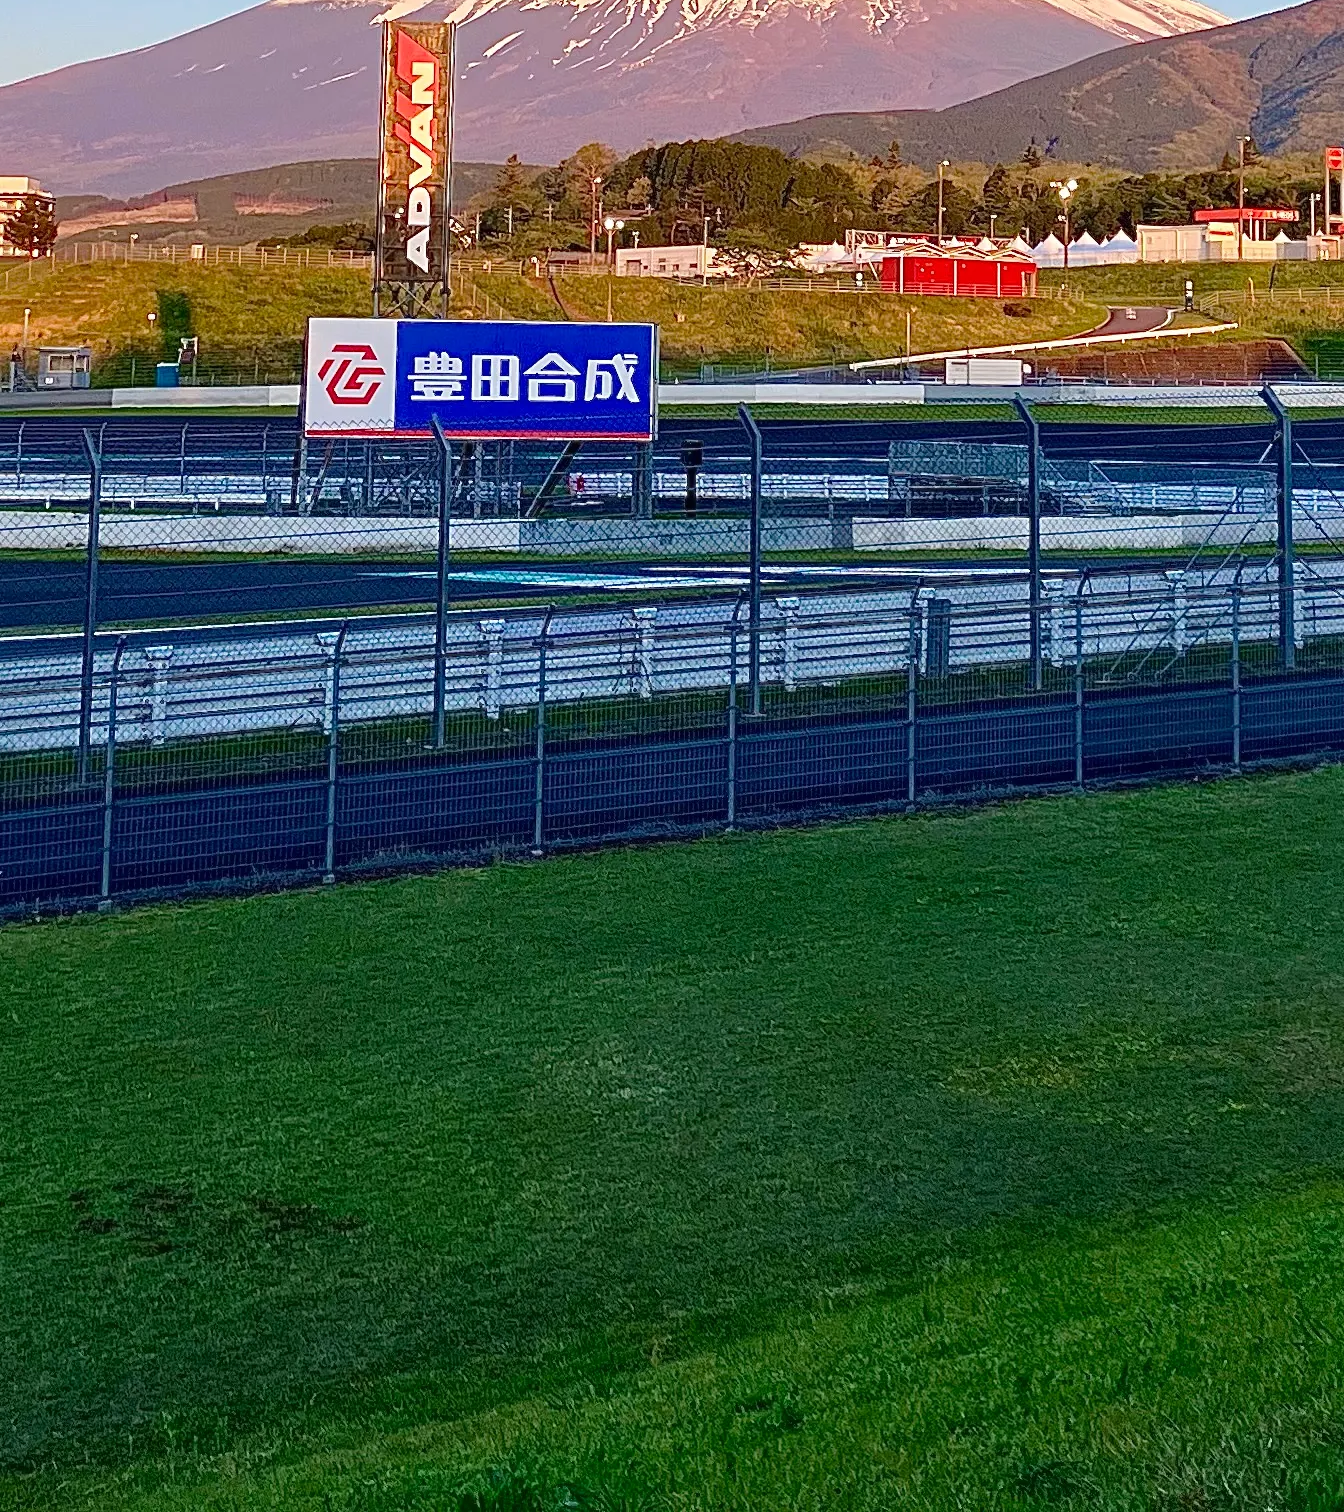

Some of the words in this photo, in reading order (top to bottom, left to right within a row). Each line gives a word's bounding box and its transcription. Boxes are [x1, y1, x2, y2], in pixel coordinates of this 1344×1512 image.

[406, 61, 435, 273] ADVAN
[408, 352, 641, 403] 豊田合成
